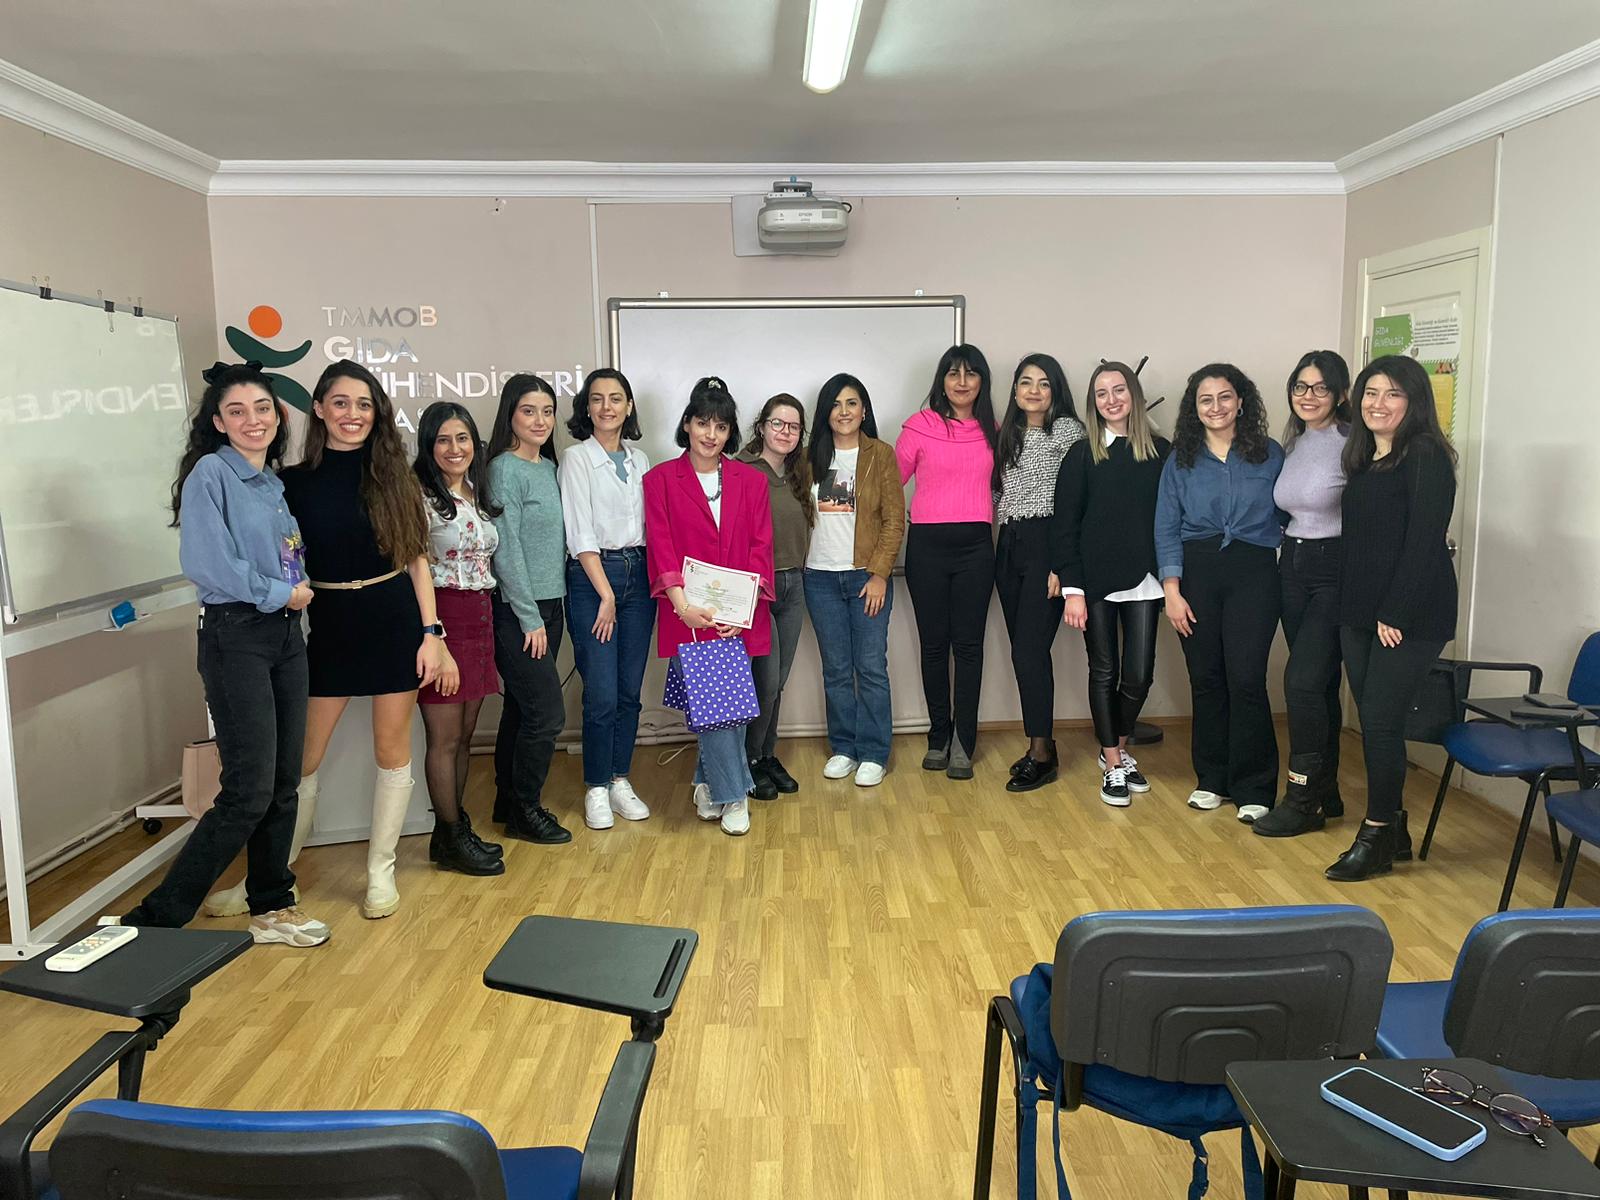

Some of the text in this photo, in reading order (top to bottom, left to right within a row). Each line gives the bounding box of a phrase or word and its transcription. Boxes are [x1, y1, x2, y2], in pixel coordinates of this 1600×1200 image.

[321, 305, 438, 328] TMMOB
[323, 335, 419, 363] GIDA
[368, 364, 584, 398] HENDİRİ
